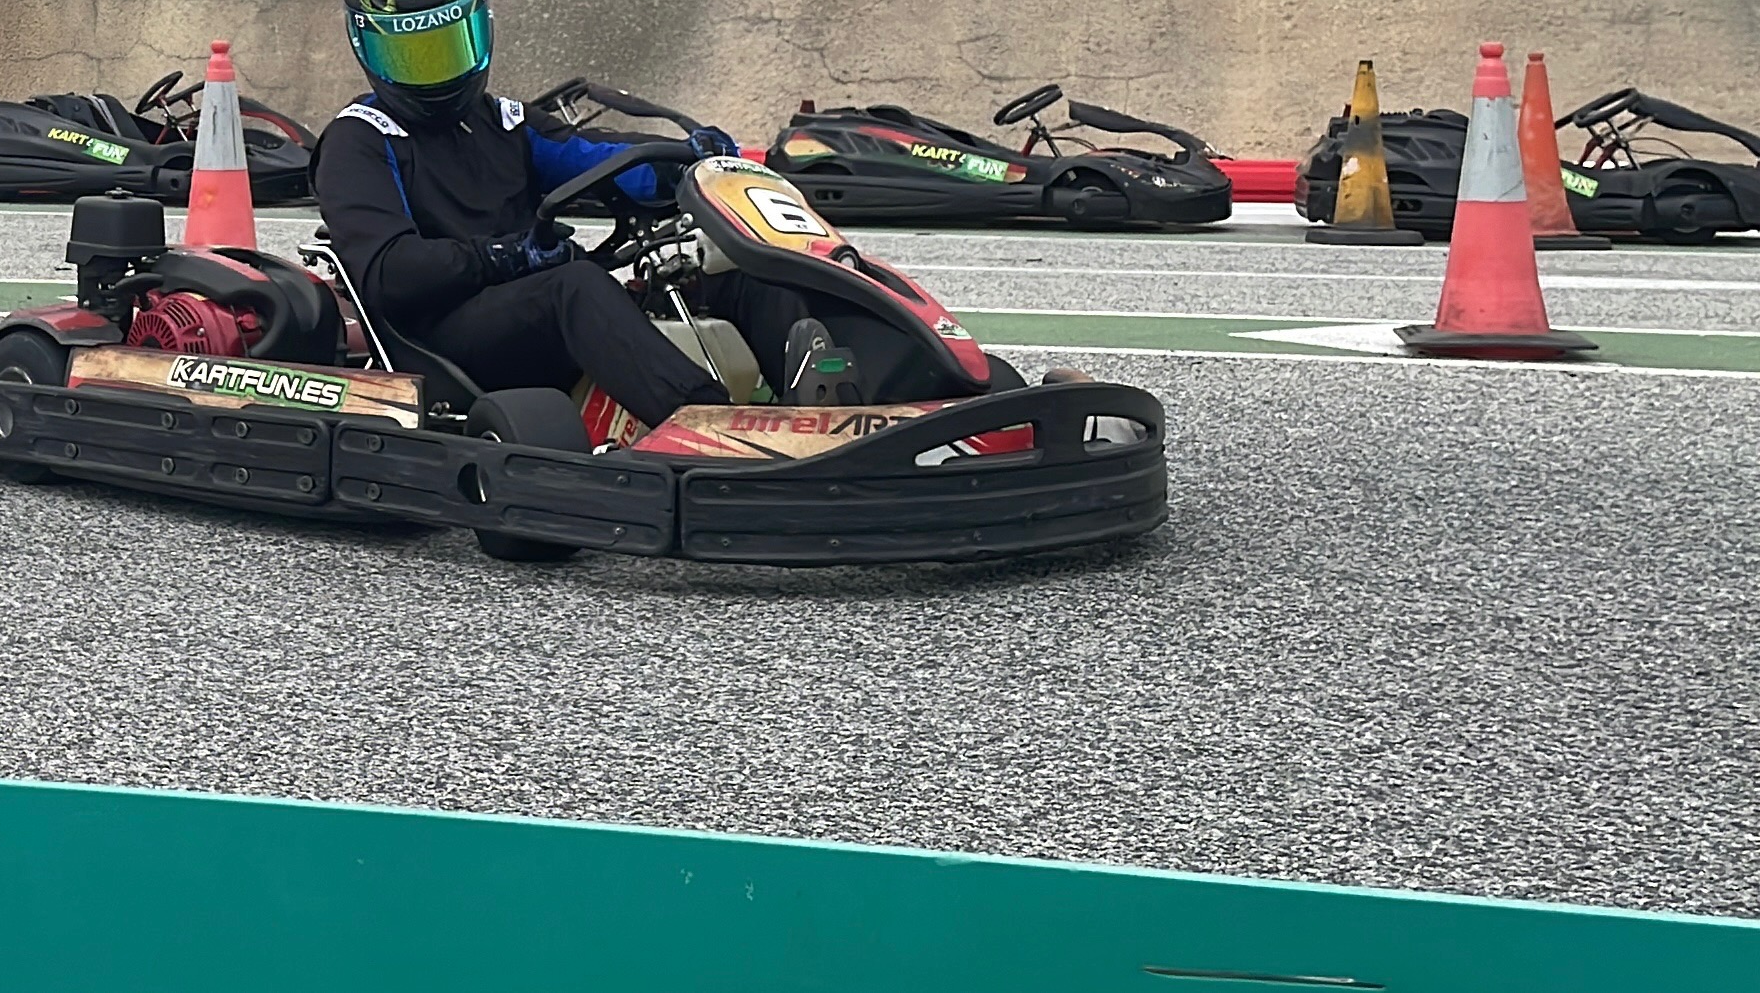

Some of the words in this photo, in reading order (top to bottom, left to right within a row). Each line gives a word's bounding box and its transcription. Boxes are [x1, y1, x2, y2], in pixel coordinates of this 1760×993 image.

[393, 5, 462, 32] LOZANO
[48, 128, 90, 145] KART
[92, 142, 124, 160] FUN
[912, 144, 961, 162] KART
[967, 158, 1005, 176] FUN
[744, 186, 830, 237] 6
[173, 358, 343, 407] KARTFUN.ES
